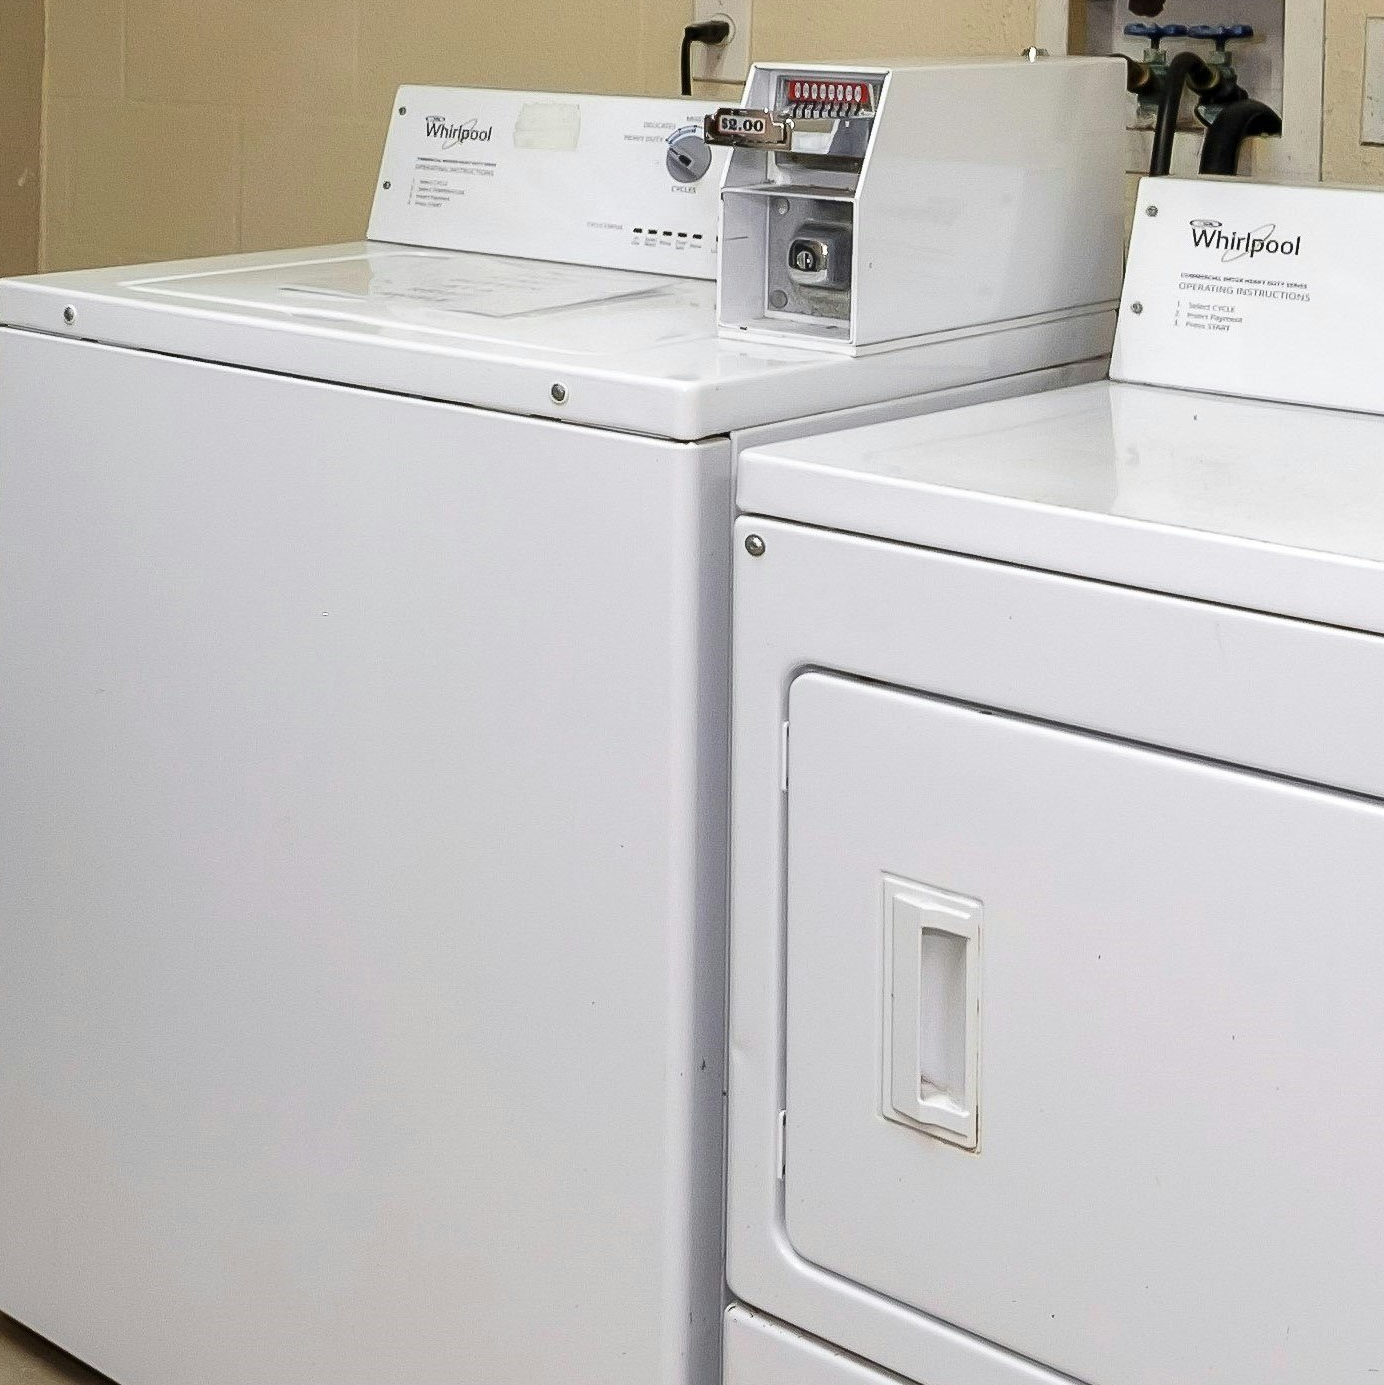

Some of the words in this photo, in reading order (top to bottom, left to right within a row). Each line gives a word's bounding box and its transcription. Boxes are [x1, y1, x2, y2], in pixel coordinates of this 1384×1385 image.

[425, 121, 493, 144] Whirlpool
[720, 117, 765, 132] $2.00
[1191, 227, 1302, 259] Whirlpool
[1178, 281, 1234, 295] OPERATING
[1236, 287, 1311, 302] INSTRUCTIONS
